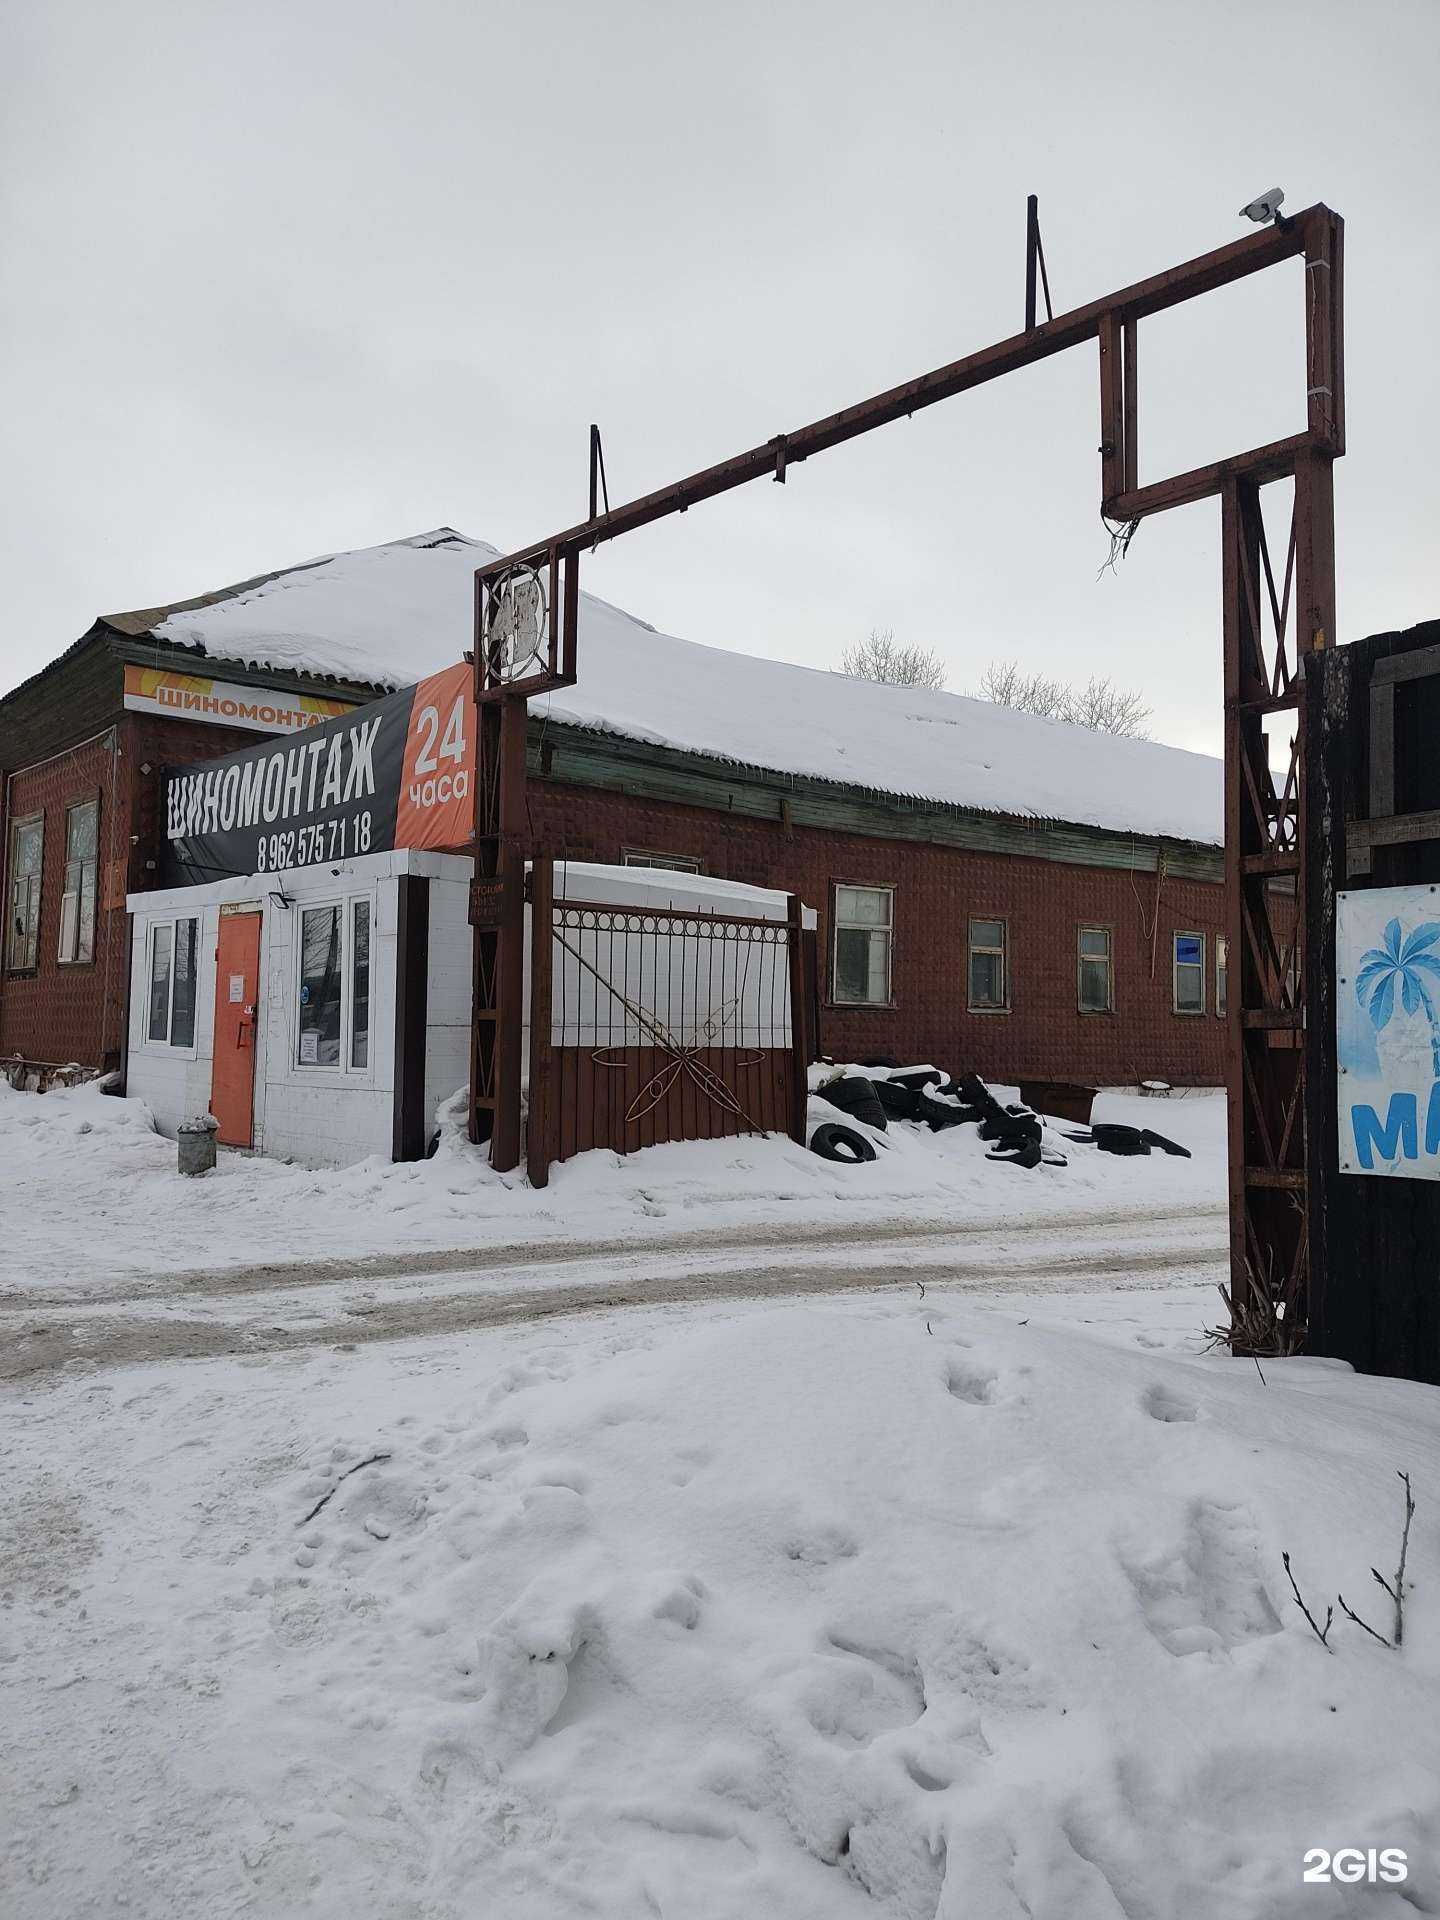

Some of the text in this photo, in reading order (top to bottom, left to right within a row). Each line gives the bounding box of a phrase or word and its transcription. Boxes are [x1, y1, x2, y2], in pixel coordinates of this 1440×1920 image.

[158, 687, 329, 728] ШИНОМОНТА
[415, 694, 466, 776] 24
[167, 715, 383, 840] ШИНОМОНТАЖ
[409, 770, 468, 809] часа
[257, 810, 372, 873] 8 962 575 71 18
